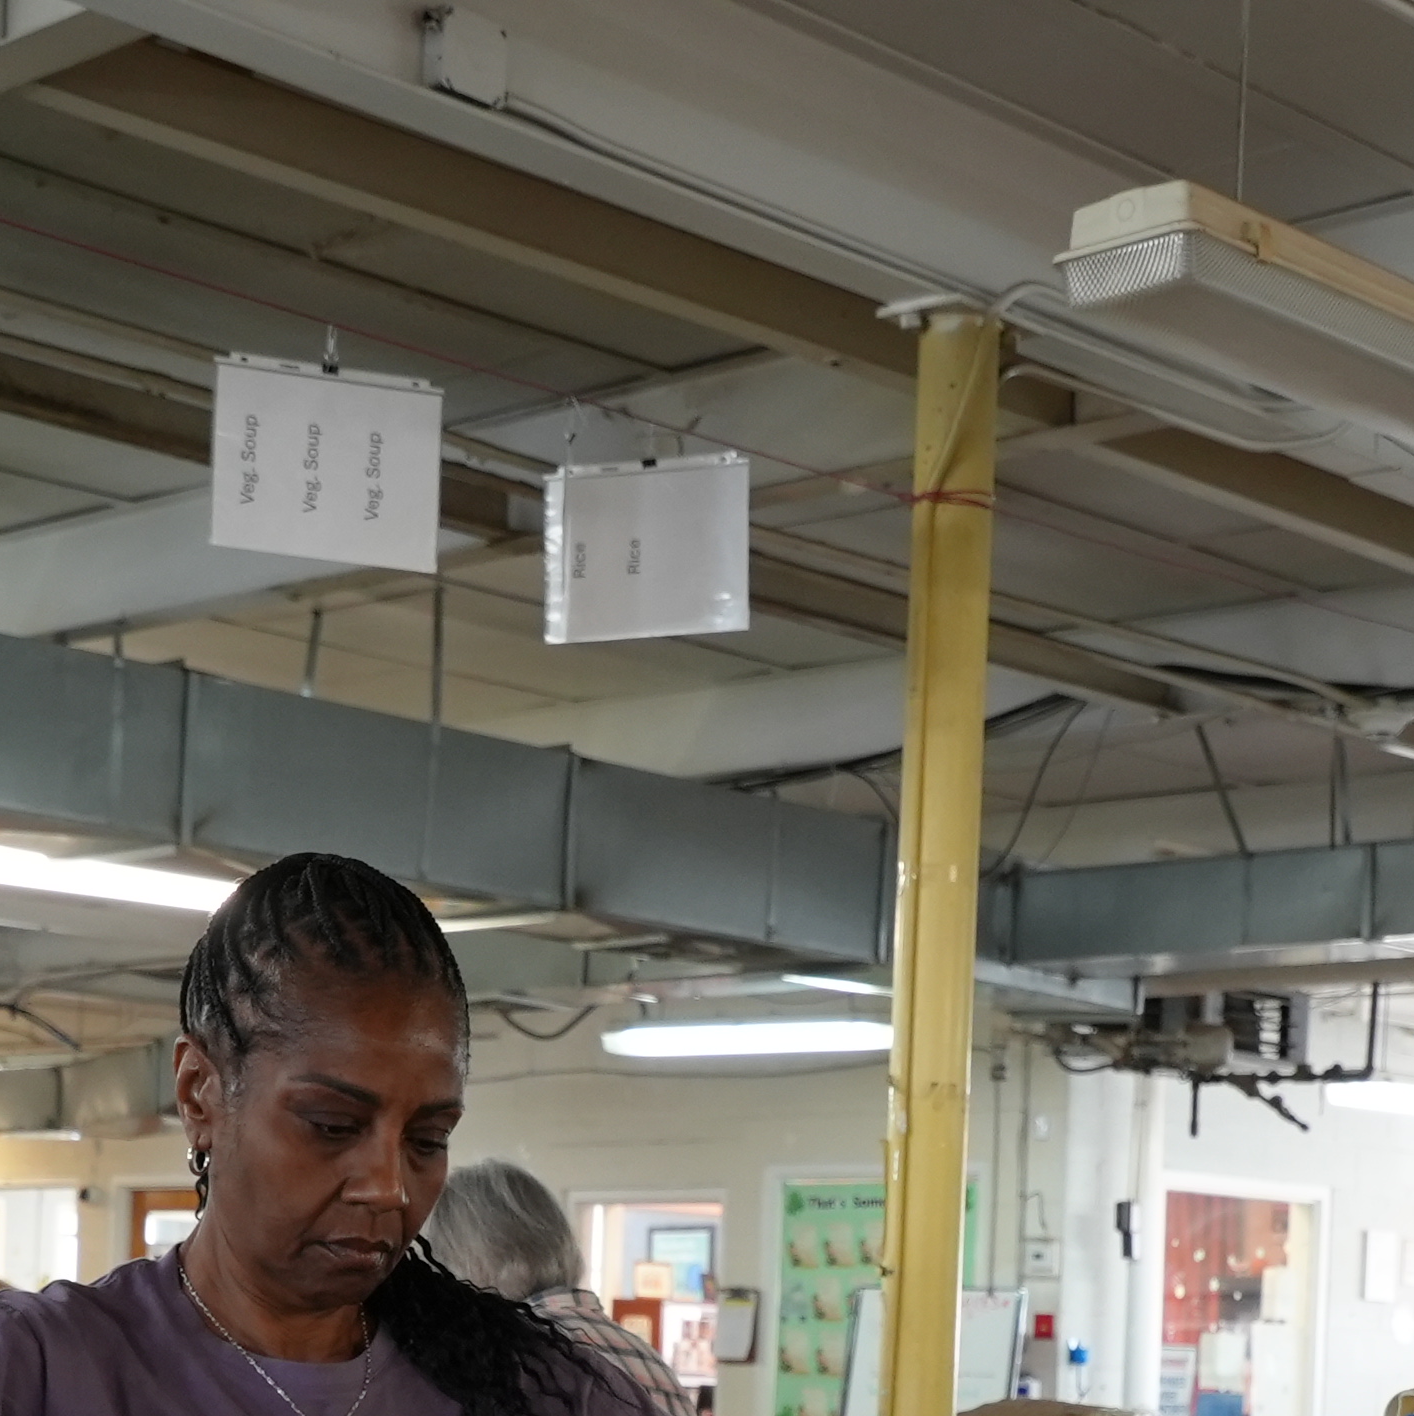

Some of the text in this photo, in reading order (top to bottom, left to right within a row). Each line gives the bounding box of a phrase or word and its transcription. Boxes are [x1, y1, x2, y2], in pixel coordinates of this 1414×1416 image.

[241, 414, 259, 505] Veg. Soup
[303, 423, 324, 514] Veg. Soup
[364, 431, 383, 521] Veg. Soup
[627, 539, 640, 575] Rice
